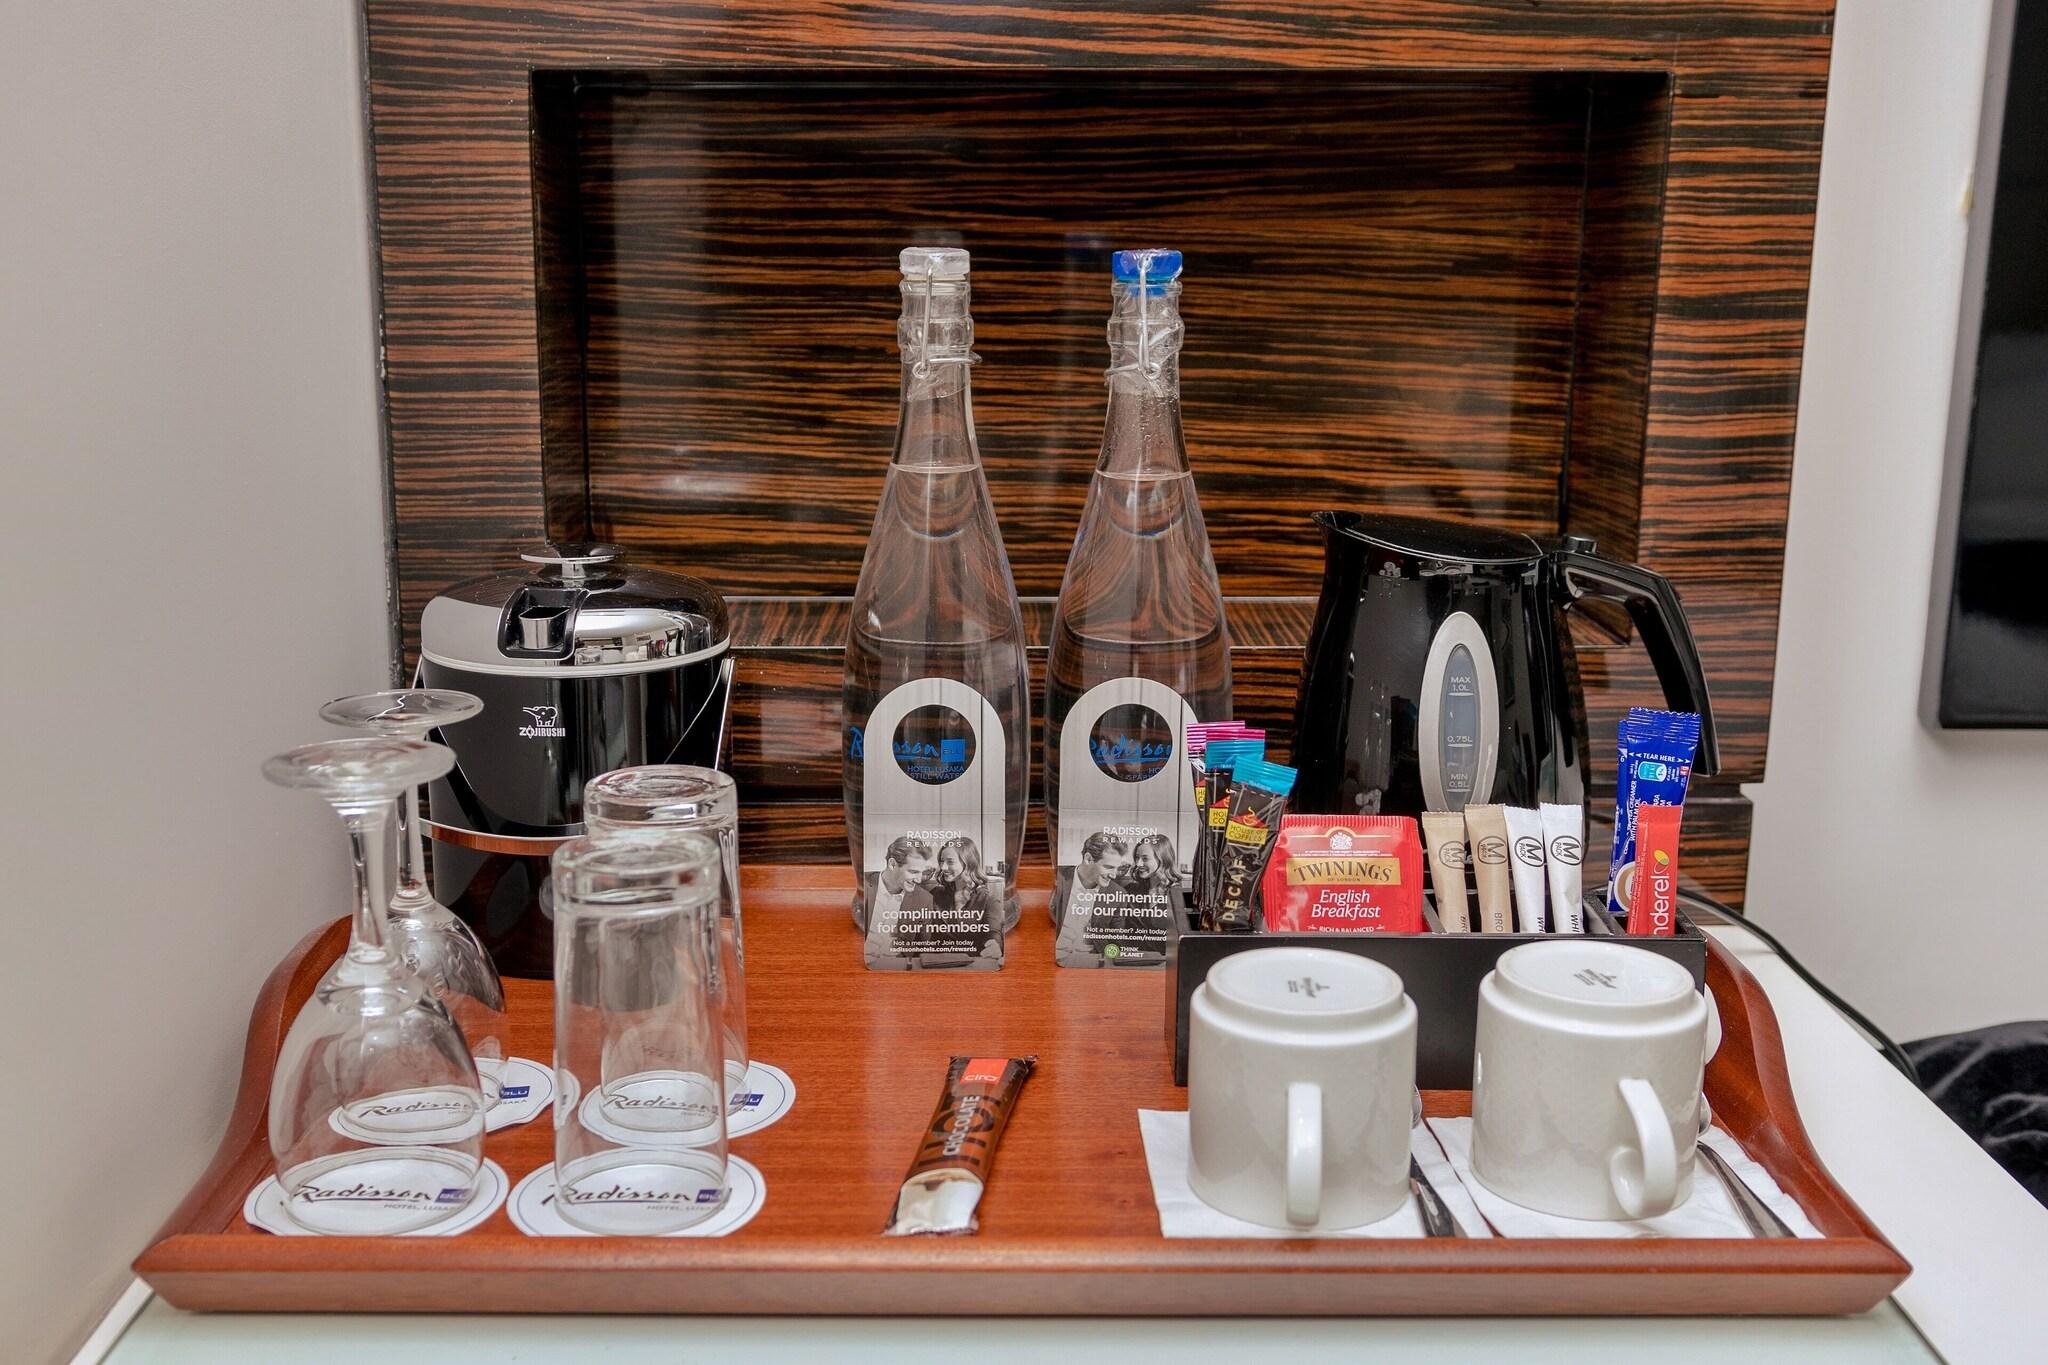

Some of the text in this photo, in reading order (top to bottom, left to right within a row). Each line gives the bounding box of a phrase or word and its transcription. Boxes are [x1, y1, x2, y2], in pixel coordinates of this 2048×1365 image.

[1450, 676, 1471, 684] MAX
[519, 725, 566, 739] ZOJIRUSHI
[1643, 752, 1659, 760] TEAR
[906, 830, 961, 839] RADISSON
[1103, 826, 1158, 836] RADISSON
[1525, 843, 1543, 862] M
[1562, 842, 1580, 861] M
[1293, 861, 1392, 882] TWININGS
[1222, 858, 1246, 921] DECAF
[1319, 889, 1370, 907] English
[882, 907, 985, 921] complimentary
[1071, 904, 1090, 915] for
[1093, 906, 1116, 917] our
[1311, 903, 1381, 921] Breakfast
[877, 922, 991, 933] for our members
[1570, 914, 1580, 932] WHI
[964, 1073, 999, 1082] ciro
[942, 1095, 981, 1156] CHOCOLATE
[294, 1183, 433, 1204] Radisson
